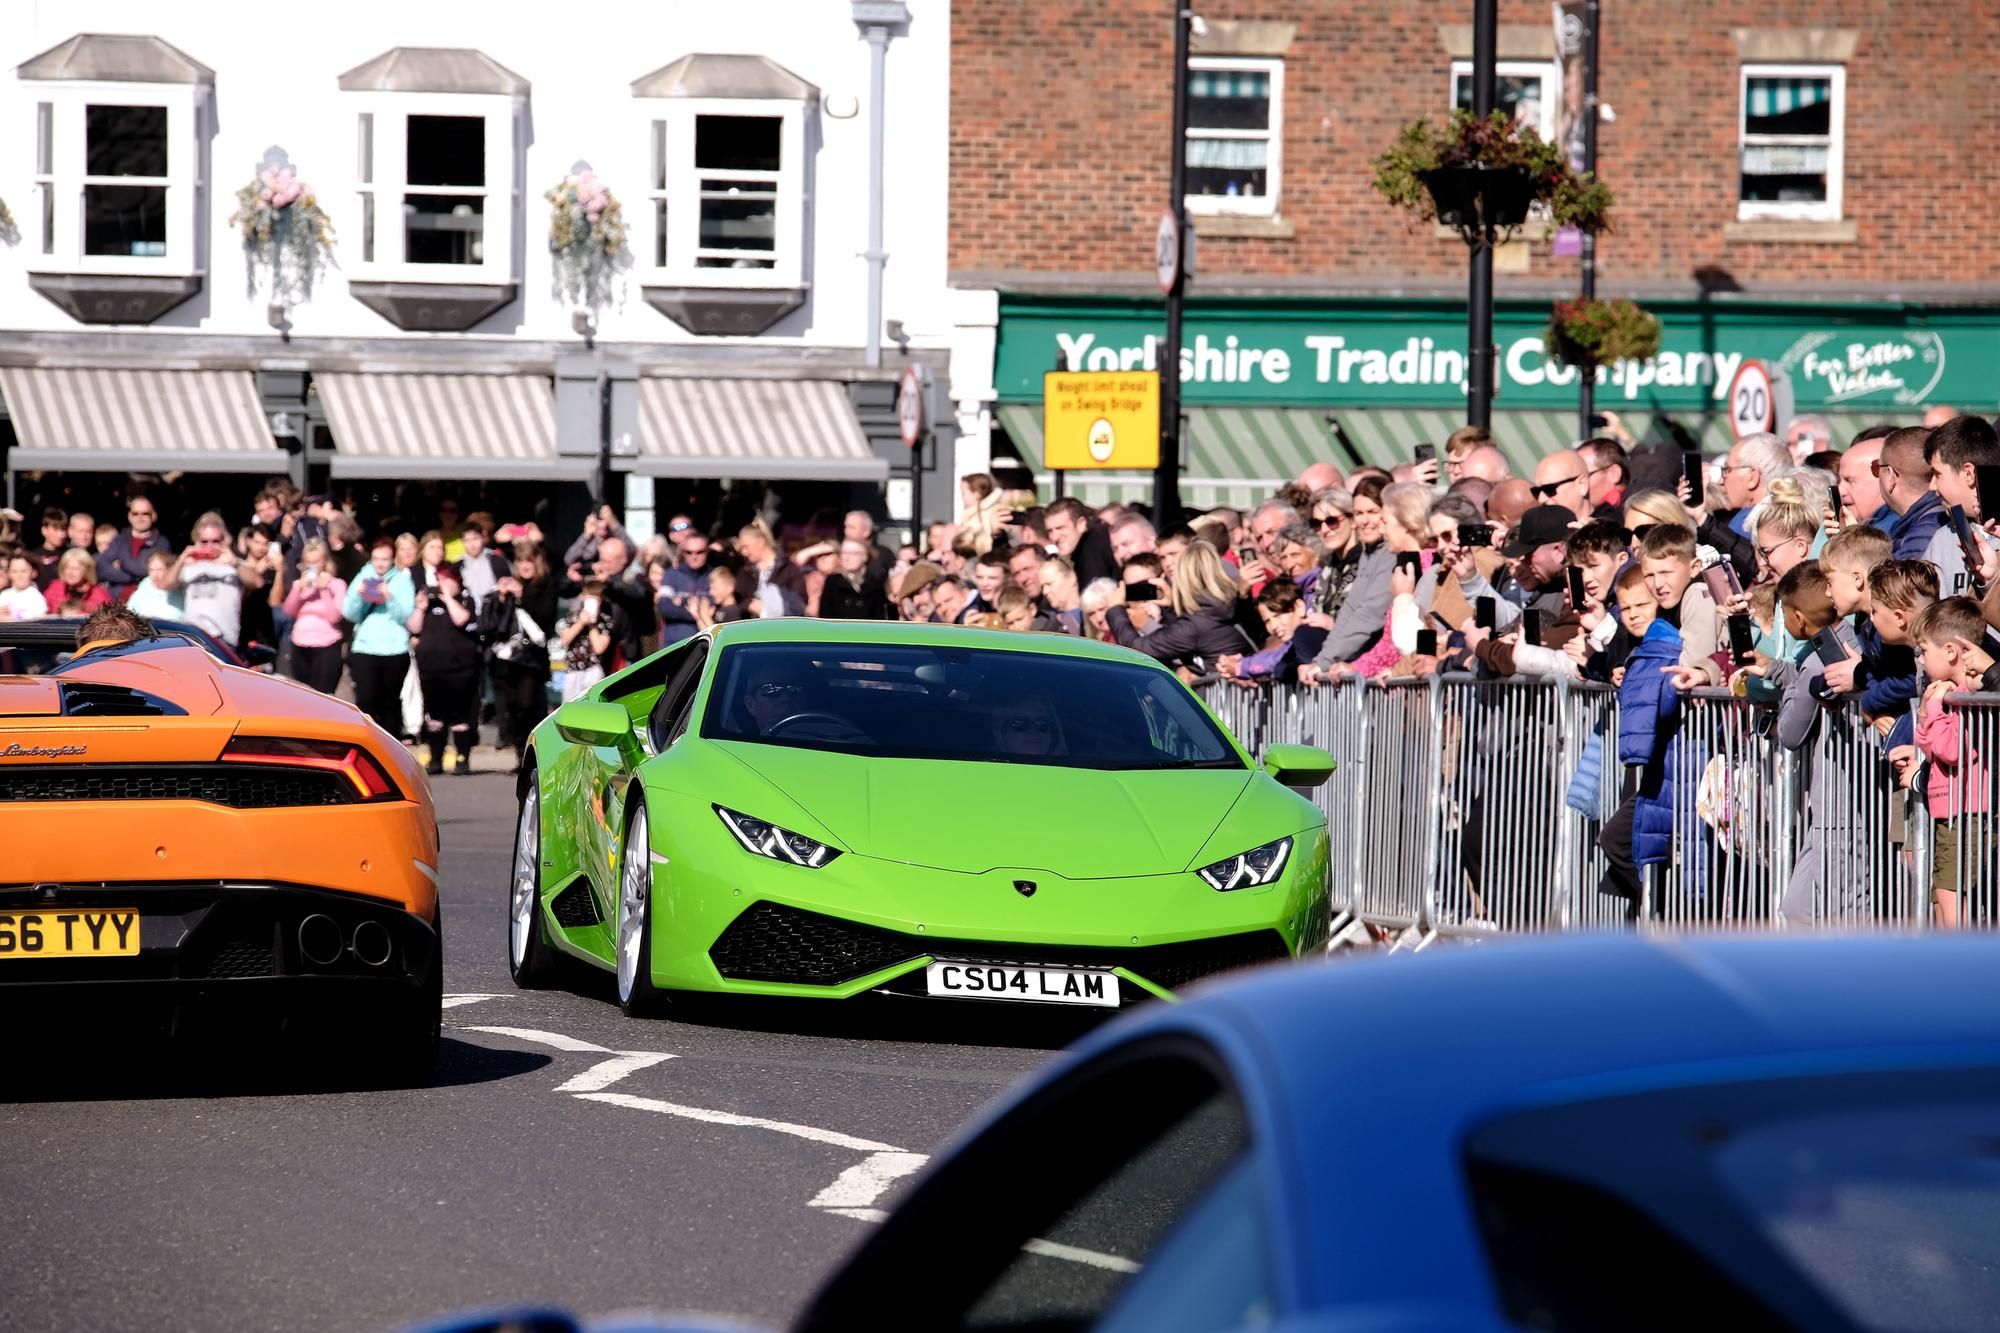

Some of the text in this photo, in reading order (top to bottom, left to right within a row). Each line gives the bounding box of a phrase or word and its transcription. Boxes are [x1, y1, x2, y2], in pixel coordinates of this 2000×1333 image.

[1304, 335, 1470, 396] Tradin
[1803, 352, 1846, 381] For
[1738, 388, 1767, 421] 20
[57, 913, 134, 951] TYY
[942, 966, 1104, 999] CS04 LAM
